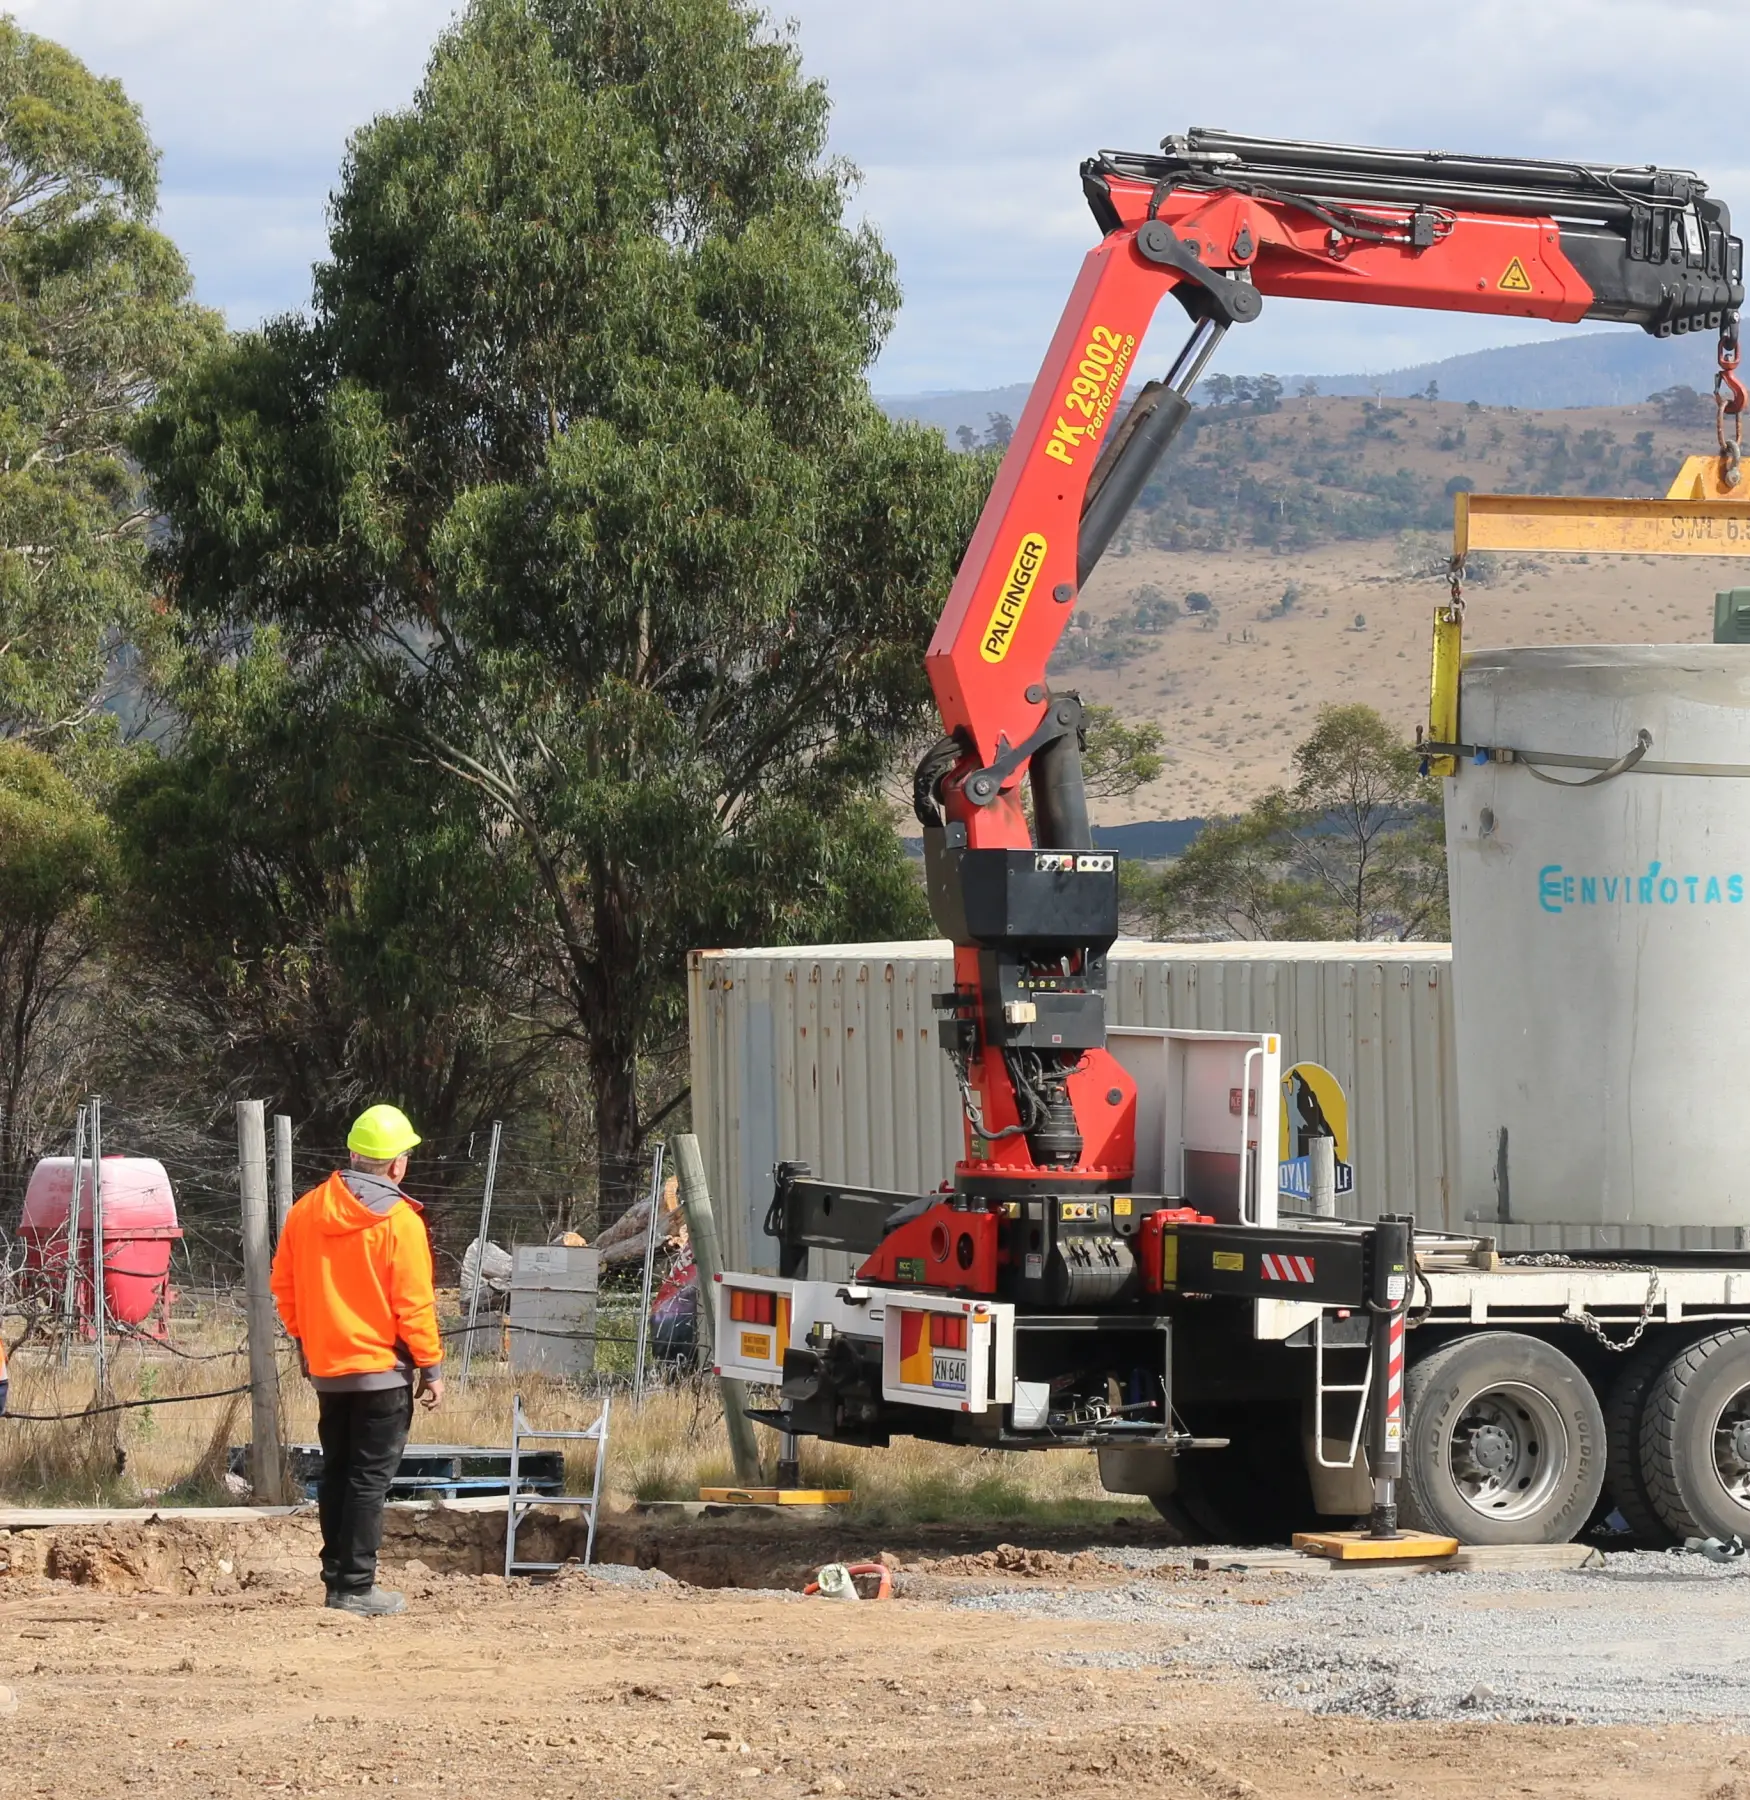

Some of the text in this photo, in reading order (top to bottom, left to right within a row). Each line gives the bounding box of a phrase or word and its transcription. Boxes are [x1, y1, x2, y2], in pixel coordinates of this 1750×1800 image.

[1045, 325, 1122, 465] PK 29002
[1085, 334, 1135, 440] Performance
[1672, 515, 1719, 540] SWL
[985, 541, 1043, 656] PALFINGER
[1279, 1160, 1311, 1194] OYAL
[934, 1359, 966, 1382] XN 640
[1573, 1410, 1592, 1482] GOLDEN
